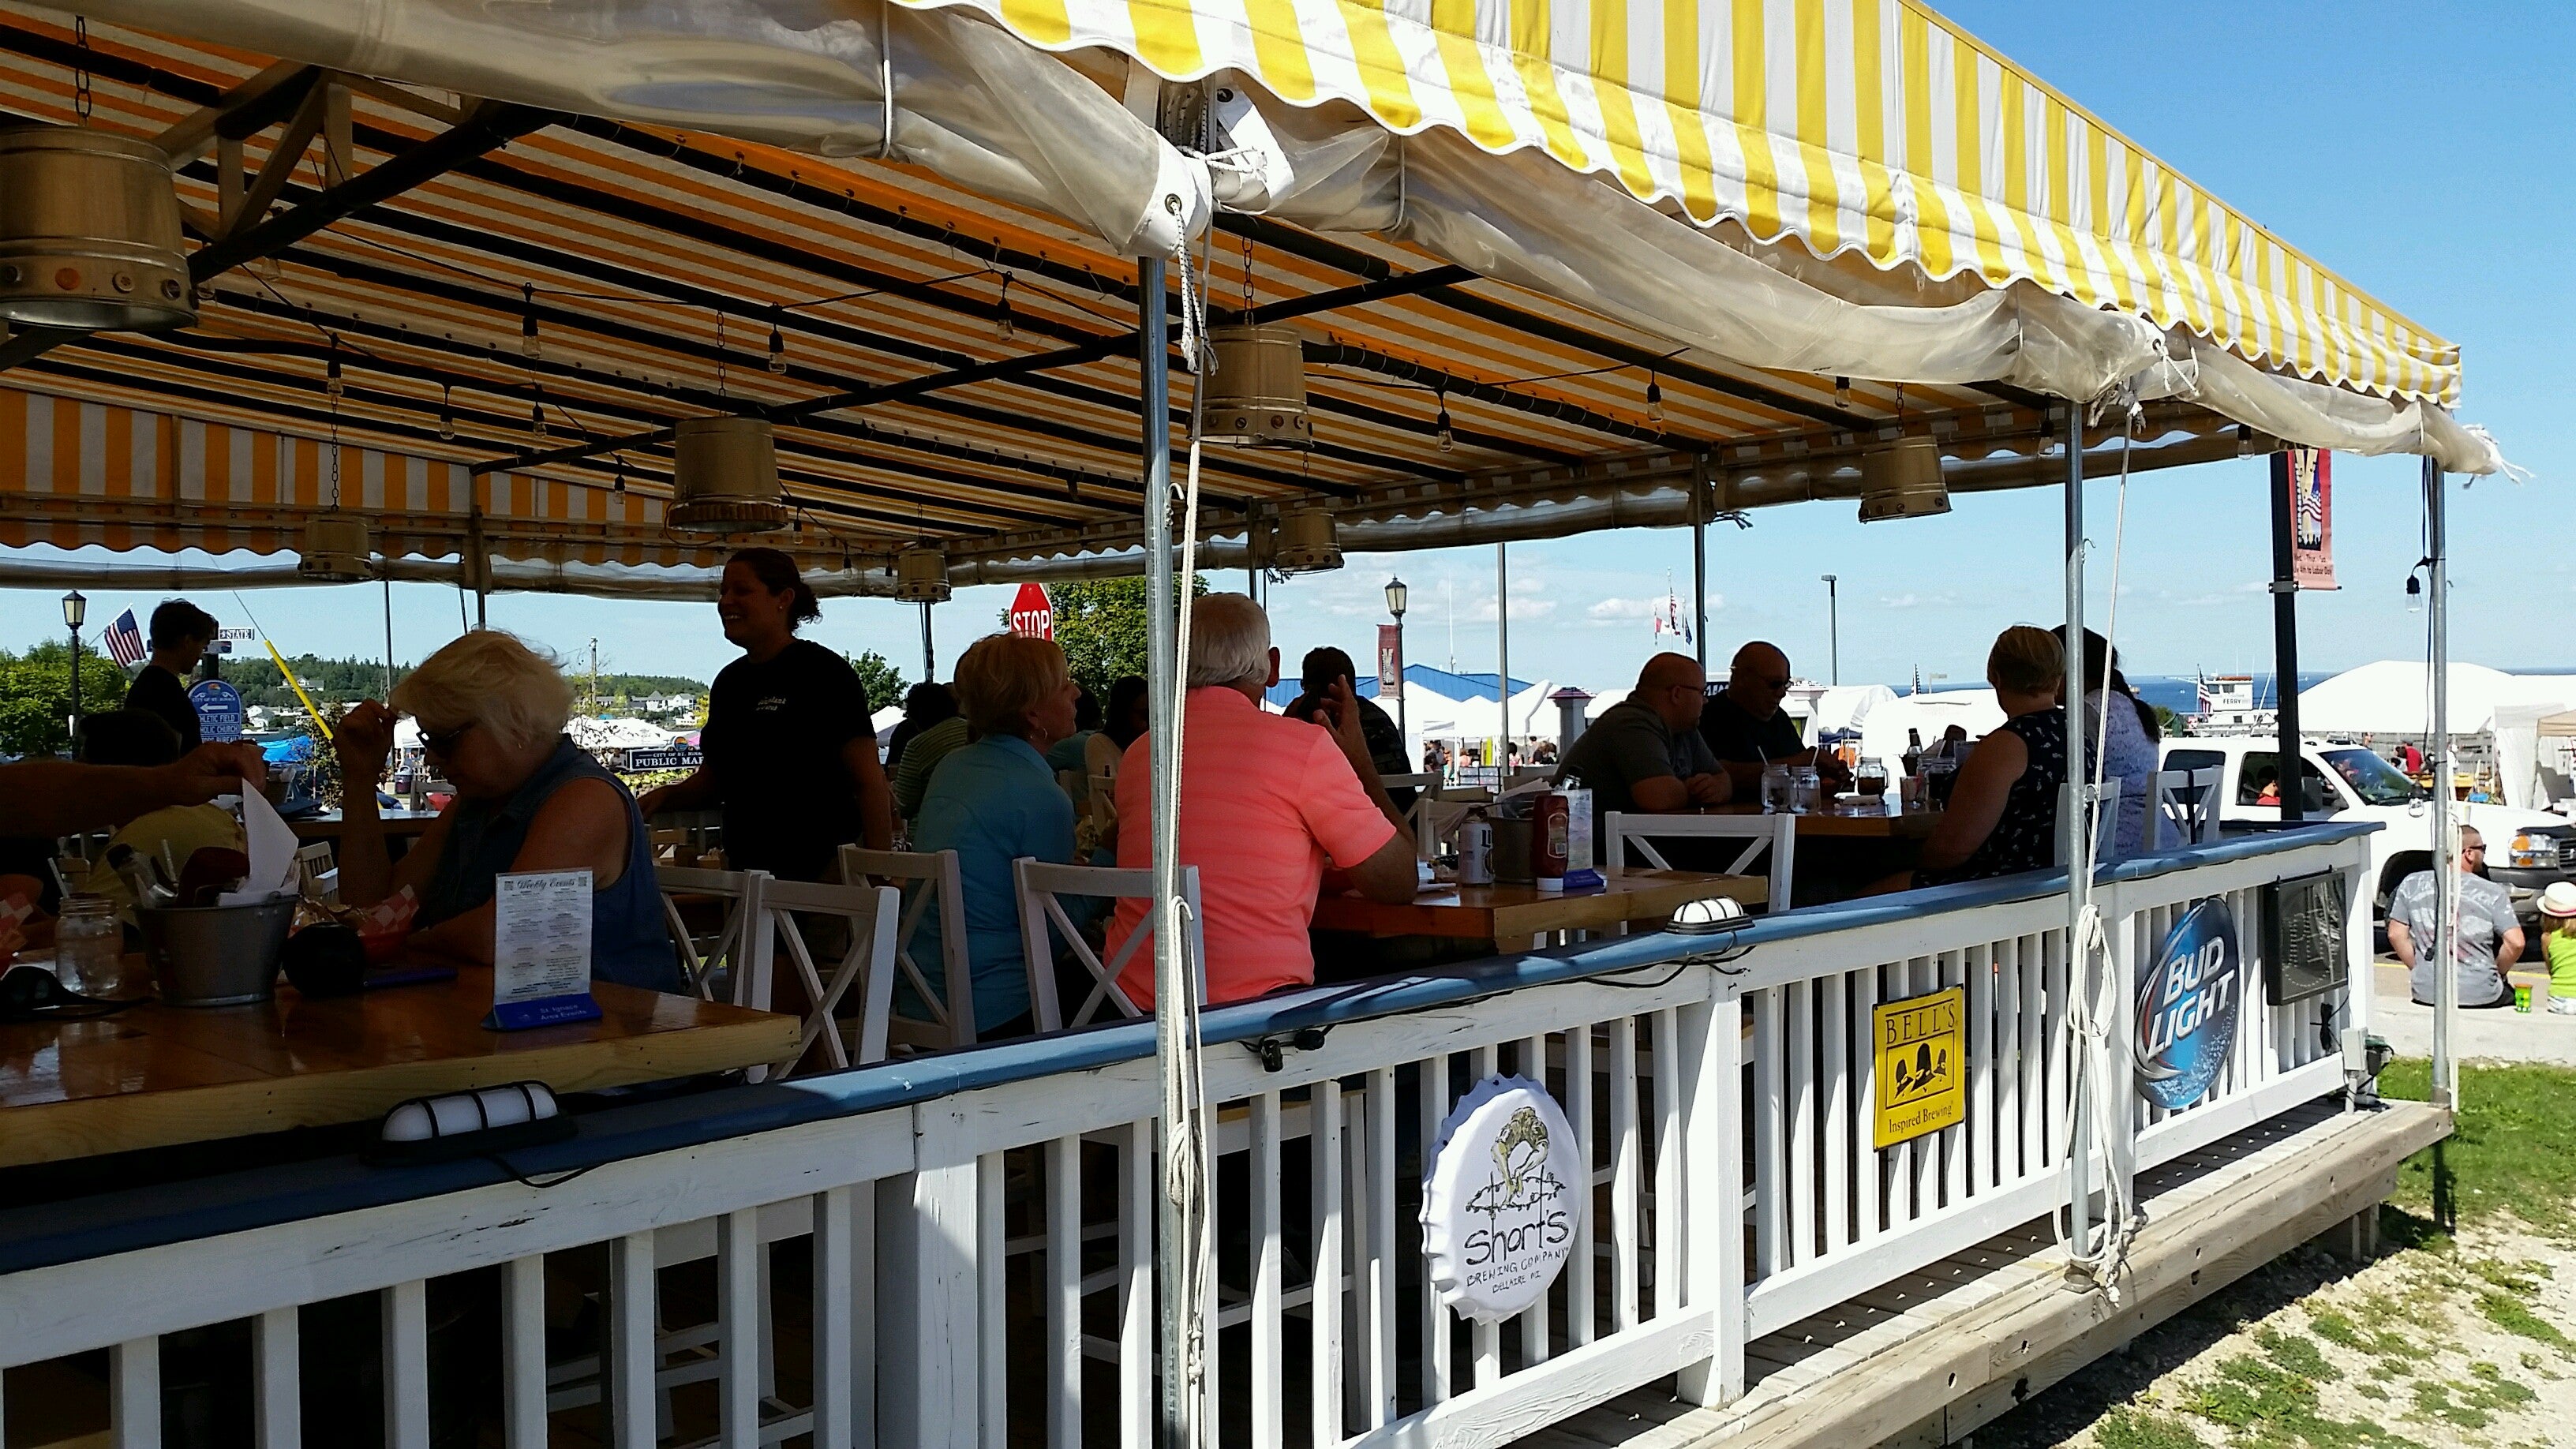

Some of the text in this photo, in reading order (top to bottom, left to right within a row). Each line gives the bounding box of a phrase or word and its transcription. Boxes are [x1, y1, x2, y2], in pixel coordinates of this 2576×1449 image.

[227, 629, 249, 639] STATE
[1013, 610, 1050, 639] STOP
[635, 756, 704, 767] PUBLIC MAR
[518, 877, 575, 891] Weekly Events
[2162, 936, 2225, 1008] BUD
[560, 1009, 588, 1018] Events
[1885, 1003, 1955, 1044] BELL'S
[2147, 968, 2235, 1060] LIGHT
[1889, 1104, 1953, 1133] Inspired Brewing
[1464, 1208, 1569, 1265] Short's
[1466, 1248, 1567, 1287] BREWING COMPANY
[1492, 1270, 1541, 1294] BELLAIRE MI
